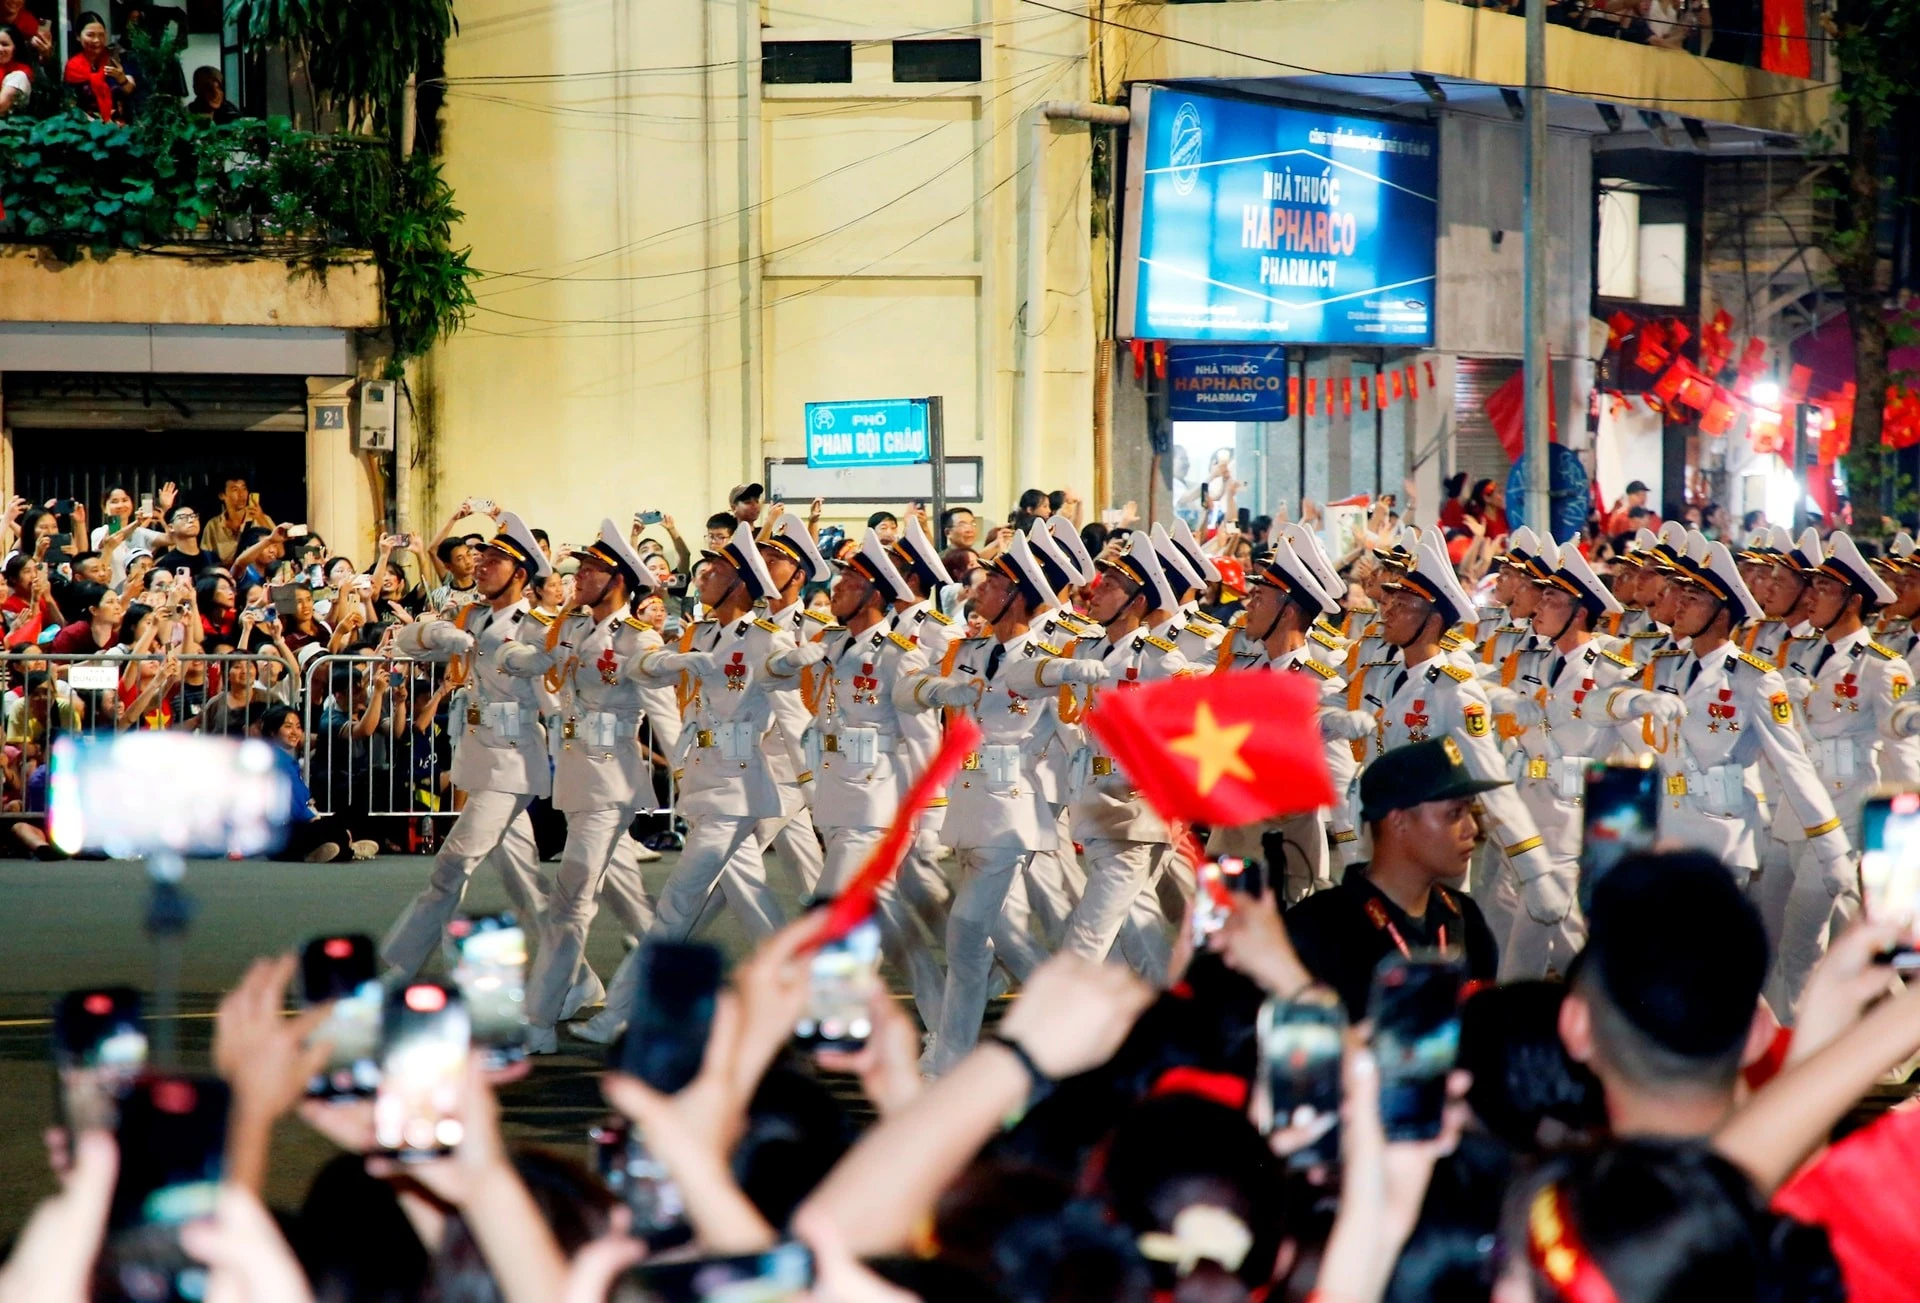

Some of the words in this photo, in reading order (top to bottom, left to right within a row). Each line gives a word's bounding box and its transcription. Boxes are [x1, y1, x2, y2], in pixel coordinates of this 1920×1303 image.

[1262, 165, 1293, 202] NHÀ
[1294, 165, 1341, 206] THUỐC
[1241, 204, 1356, 256] HAPHARCO
[1260, 255, 1337, 288] PHARMACY
[1195, 363, 1219, 375] NHÀ
[1221, 361, 1259, 375] THUỐC
[1174, 376, 1281, 391] HAPHARCO
[1196, 393, 1258, 403] PHARMACY
[852, 410, 887, 426] PHỐ
[812, 433, 852, 456] PHAN
[855, 428, 881, 459] BỘI
[883, 427, 922, 454] CHÂU
